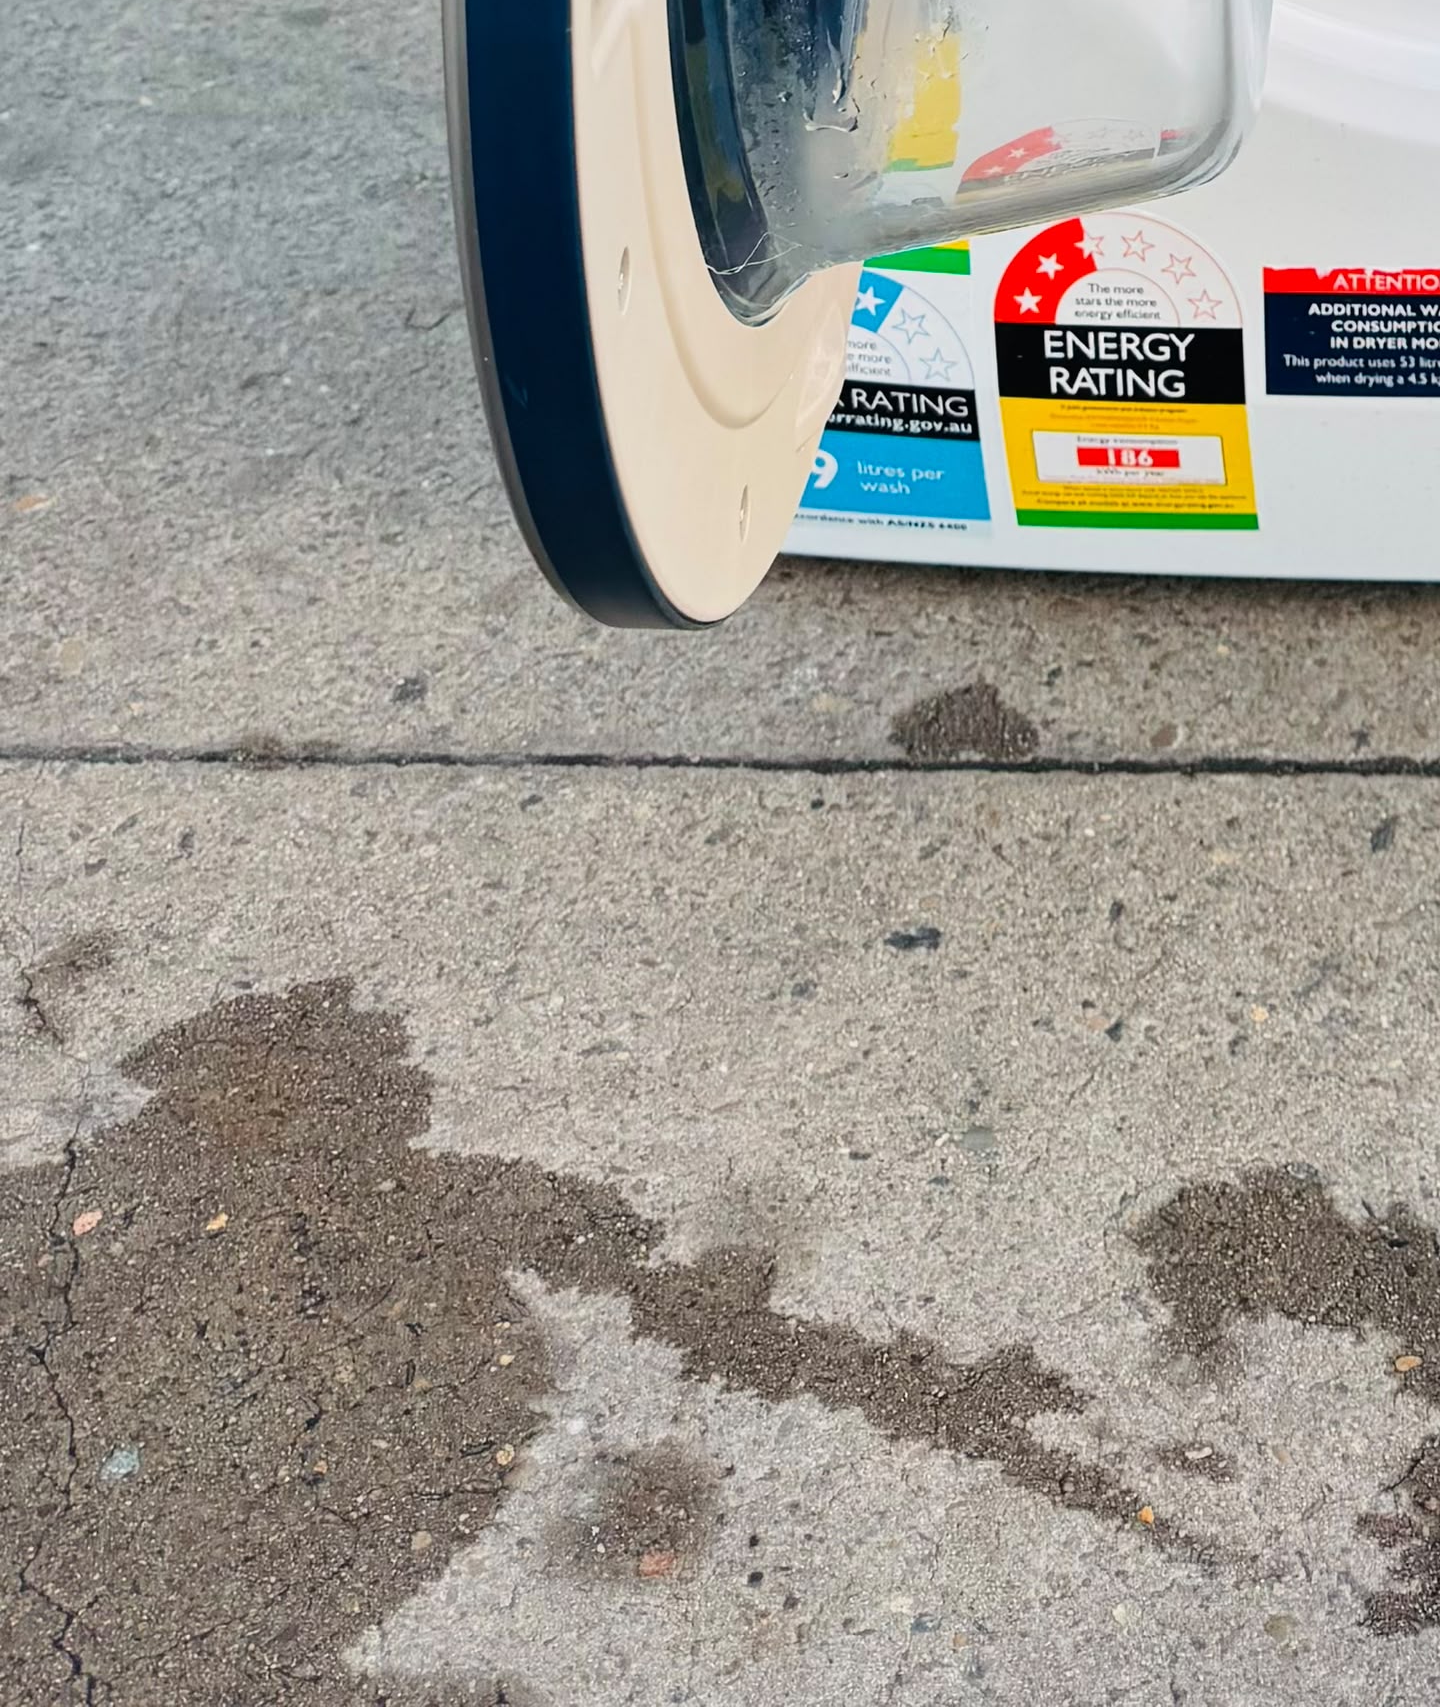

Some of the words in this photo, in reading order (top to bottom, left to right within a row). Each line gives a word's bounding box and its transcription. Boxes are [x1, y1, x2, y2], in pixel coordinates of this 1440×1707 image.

[1088, 283, 1111, 294] The
[1113, 285, 1144, 295] more
[1075, 297, 1102, 306] stars
[1104, 296, 1124, 307] the
[1126, 298, 1157, 308] more
[1308, 302, 1417, 317] ADDITIONAL
[1074, 311, 1113, 322] energy
[1116, 309, 1161, 321] efficient
[1043, 329, 1195, 363] ENERGY
[1330, 336, 1349, 349] IN
[1353, 337, 1408, 350] DRYER
[858, 354, 893, 364] more
[1283, 354, 1310, 367] This
[1313, 355, 1364, 371] product
[1368, 358, 1396, 368] uses
[1399, 356, 1416, 368] 53
[1049, 366, 1185, 399] RATING
[1315, 372, 1350, 384] when
[1354, 373, 1394, 388] drying
[1396, 376, 1405, 385] a
[1407, 373, 1427, 385] 4.5
[852, 388, 969, 417] RATING
[1106, 448, 1154, 467] 186
[857, 460, 905, 478] litres
[911, 468, 945, 482] per
[860, 480, 911, 495] wash
